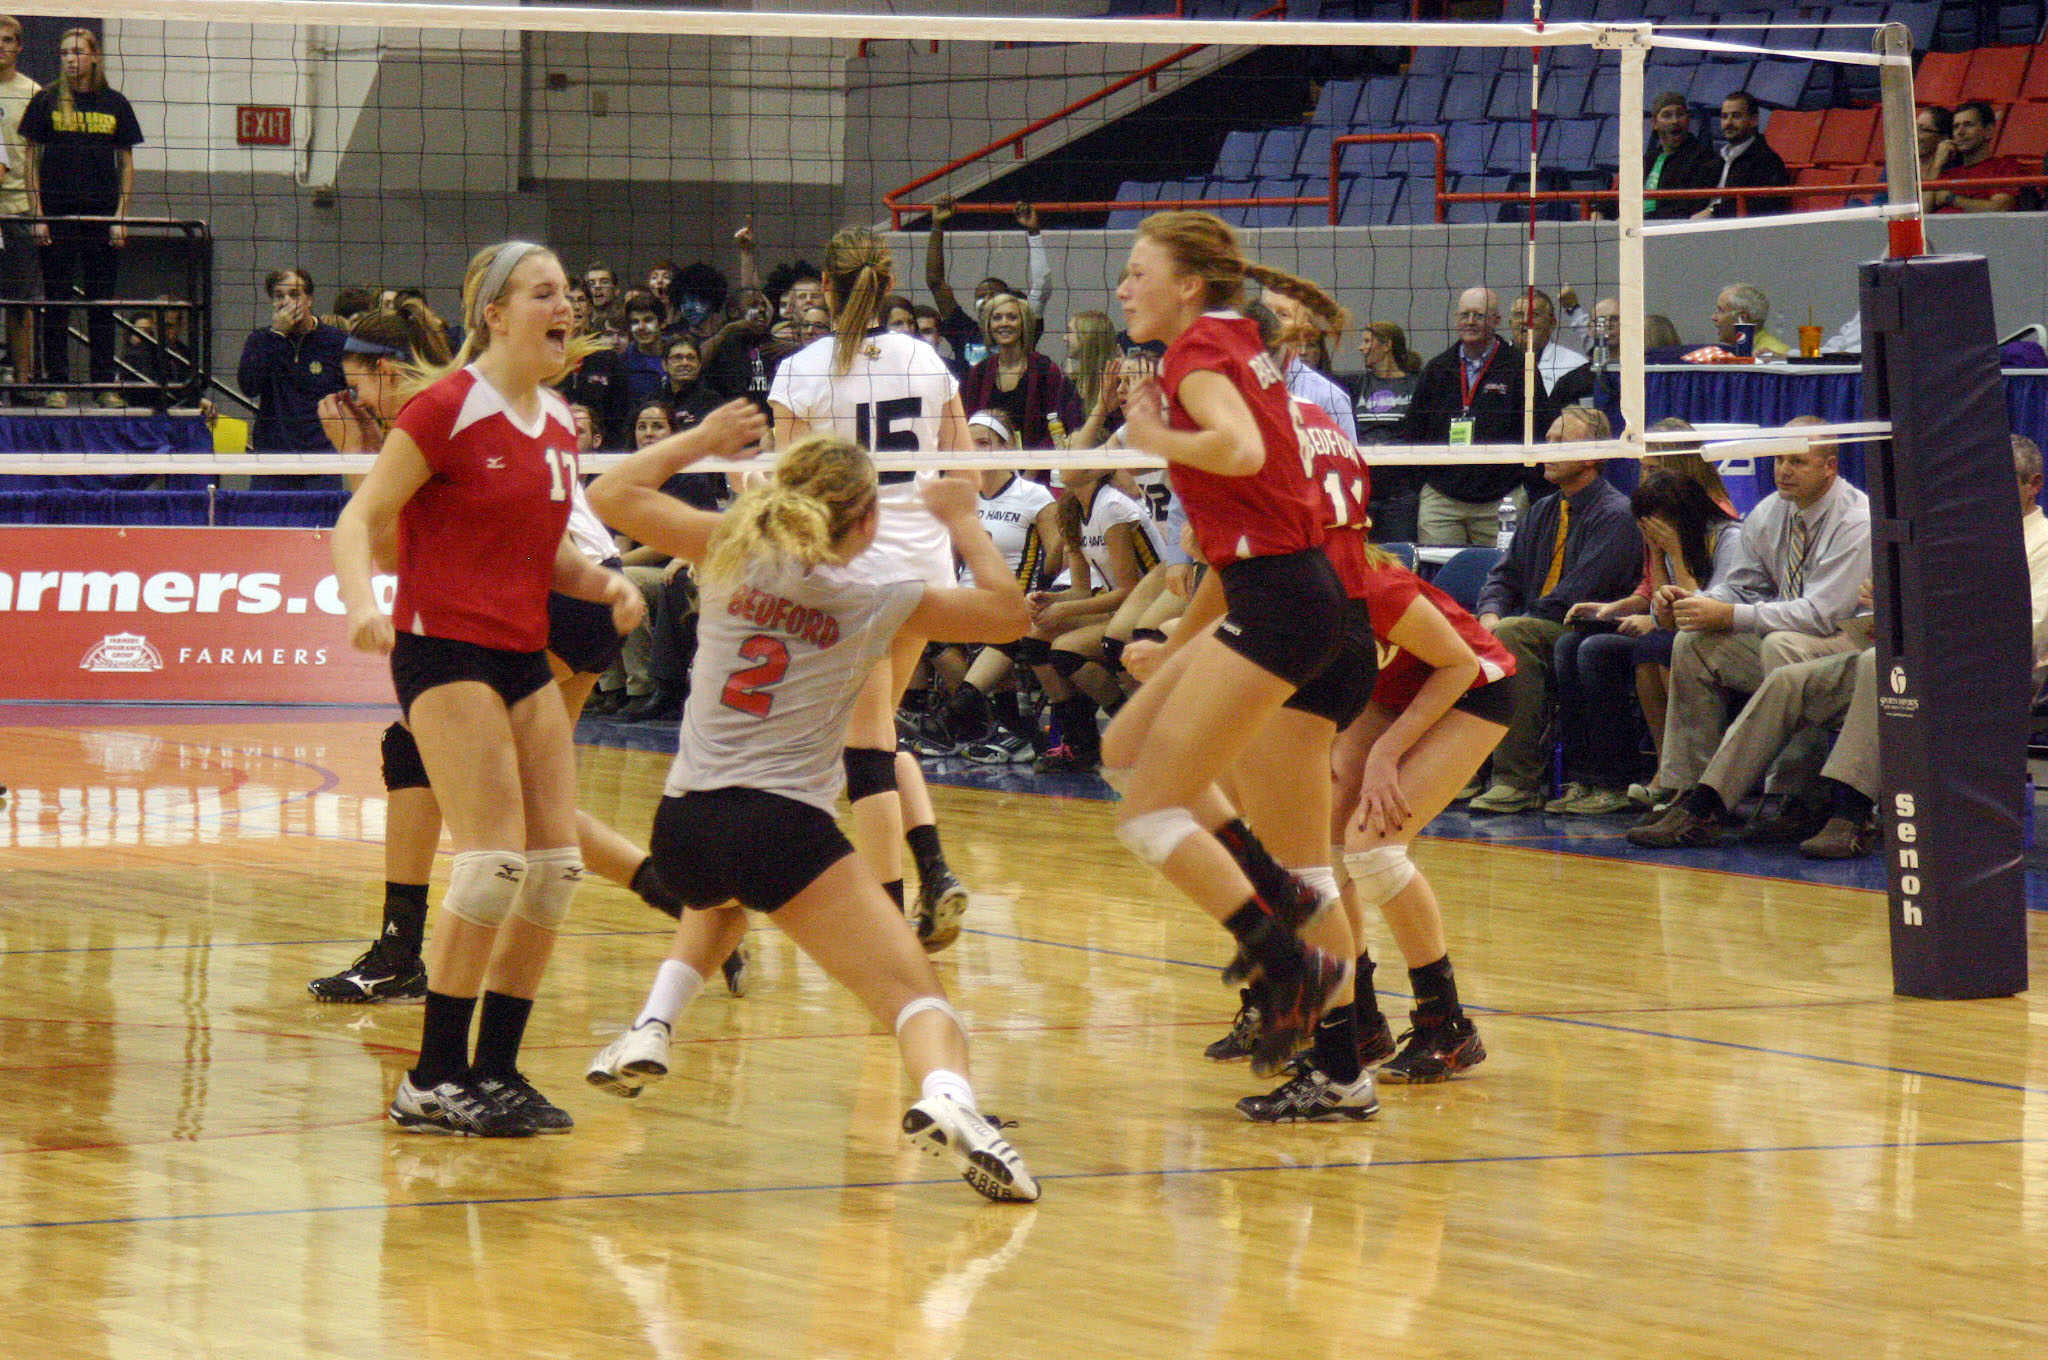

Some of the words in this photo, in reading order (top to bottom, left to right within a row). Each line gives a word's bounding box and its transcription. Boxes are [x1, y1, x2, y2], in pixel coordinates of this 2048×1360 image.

[241, 110, 287, 138] EXIT
[855, 396, 923, 486] 15
[986, 509, 1021, 523] HAVEN
[0, 571, 399, 616] rmers.co
[727, 583, 841, 651] BEDFORD
[178, 647, 328, 665] FARMERS
[720, 633, 792, 720] 2
